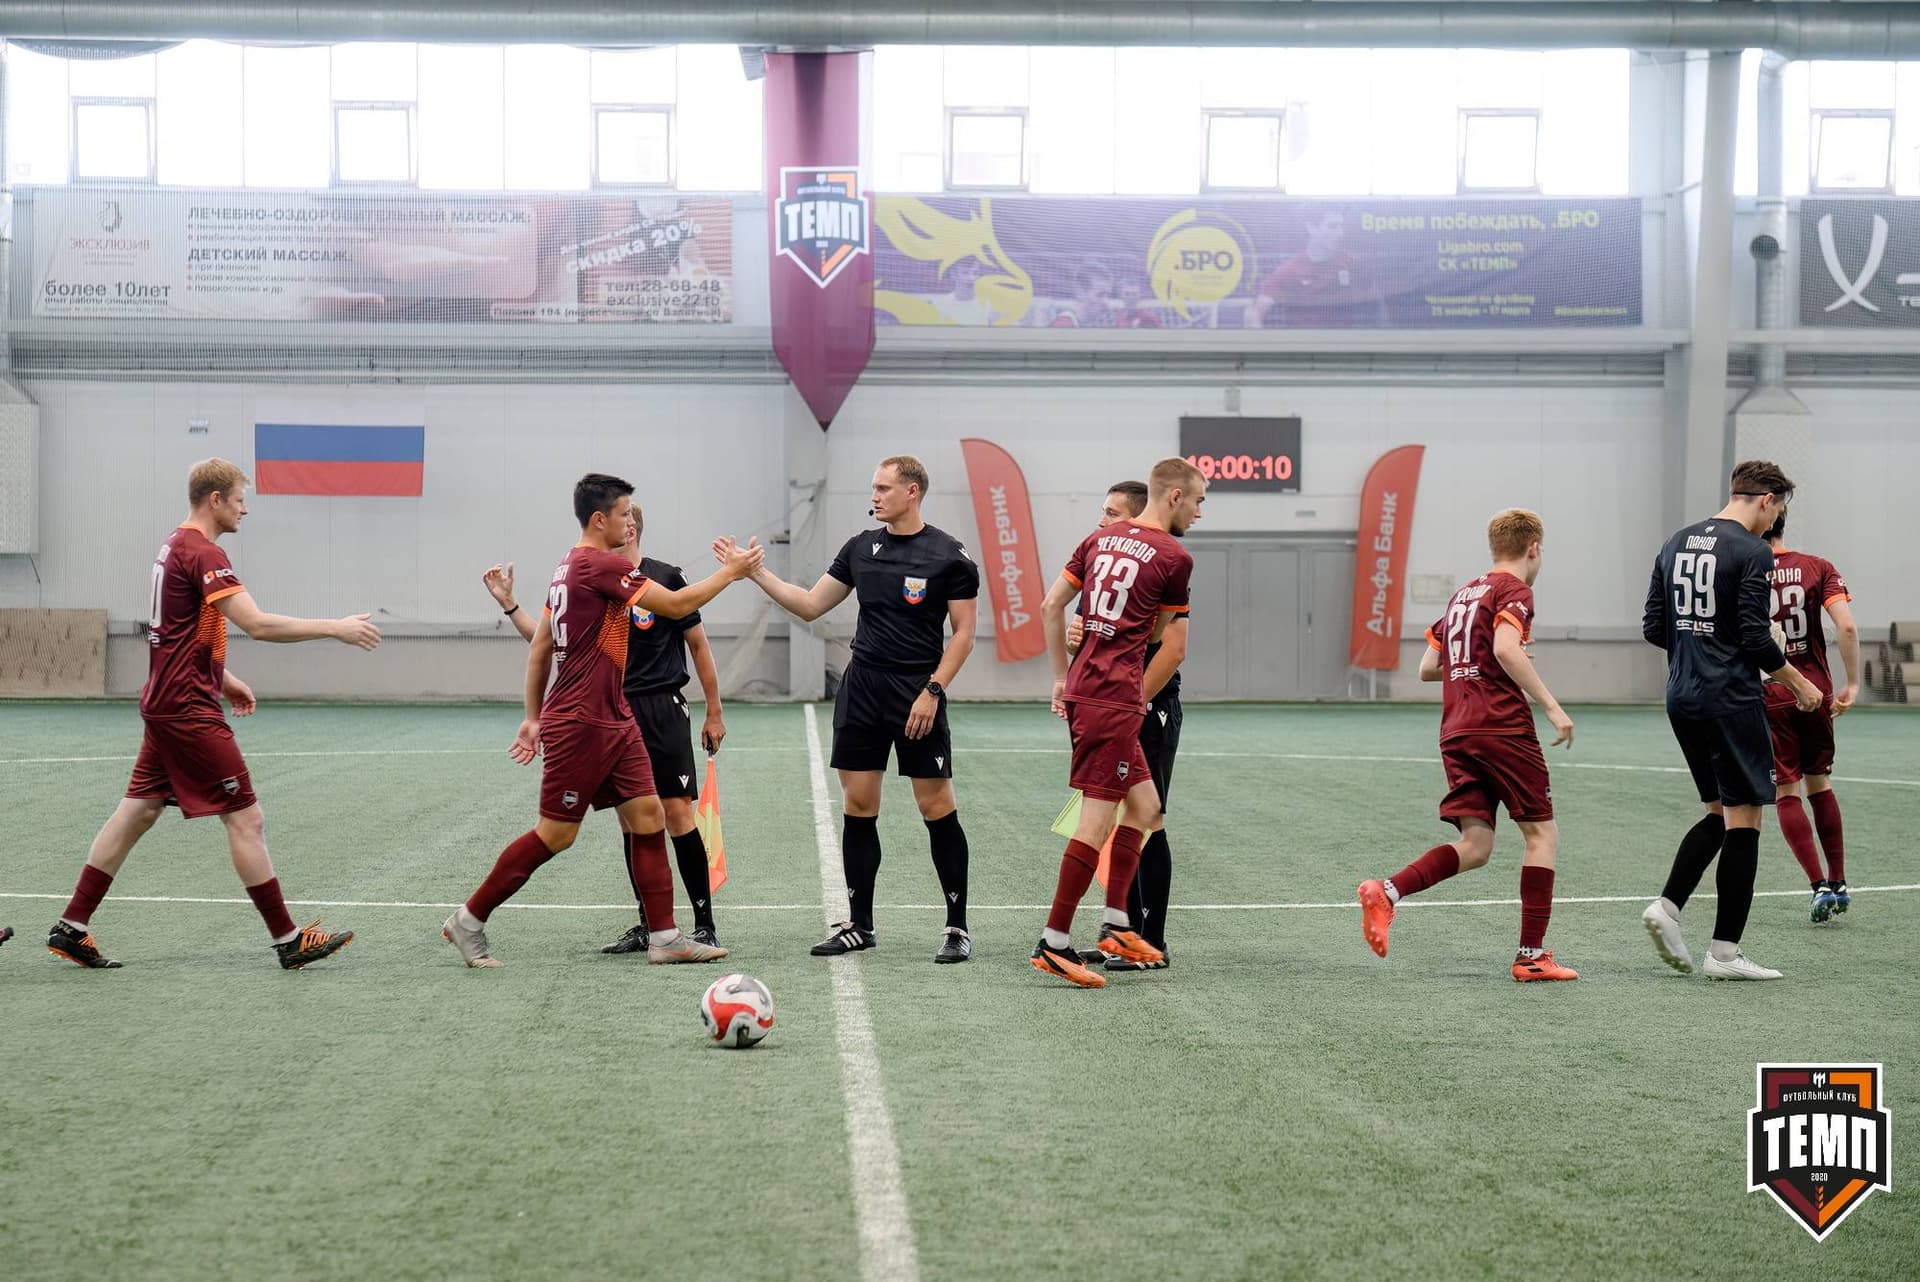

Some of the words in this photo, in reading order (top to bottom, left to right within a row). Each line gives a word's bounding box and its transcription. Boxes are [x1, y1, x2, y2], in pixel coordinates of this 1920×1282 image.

[451, 209, 531, 224] МАССАЖ:
[784, 200, 860, 242] ТЕМП
[1360, 212, 1424, 232] Время
[1430, 211, 1546, 232] побеждать,
[651, 217, 703, 248] 20%
[69, 238, 151, 250] ЭКСКЛЮЗИВ
[187, 246, 267, 262] ДЕТСКИЙ
[1173, 249, 1234, 271] .БРО
[1438, 258, 1457, 271] СК
[1461, 258, 1519, 272] «ТЕМП»
[45, 279, 107, 297] более
[115, 281, 171, 298] 10лет
[1374, 491, 1398, 552] Банк
[1097, 536, 1157, 563] ЧЕРКАСОВ
[1686, 535, 1717, 551] ПАНОВ
[1673, 552, 1717, 618] 59
[1366, 557, 1393, 636] Альфа
[1448, 600, 1480, 666] 21
